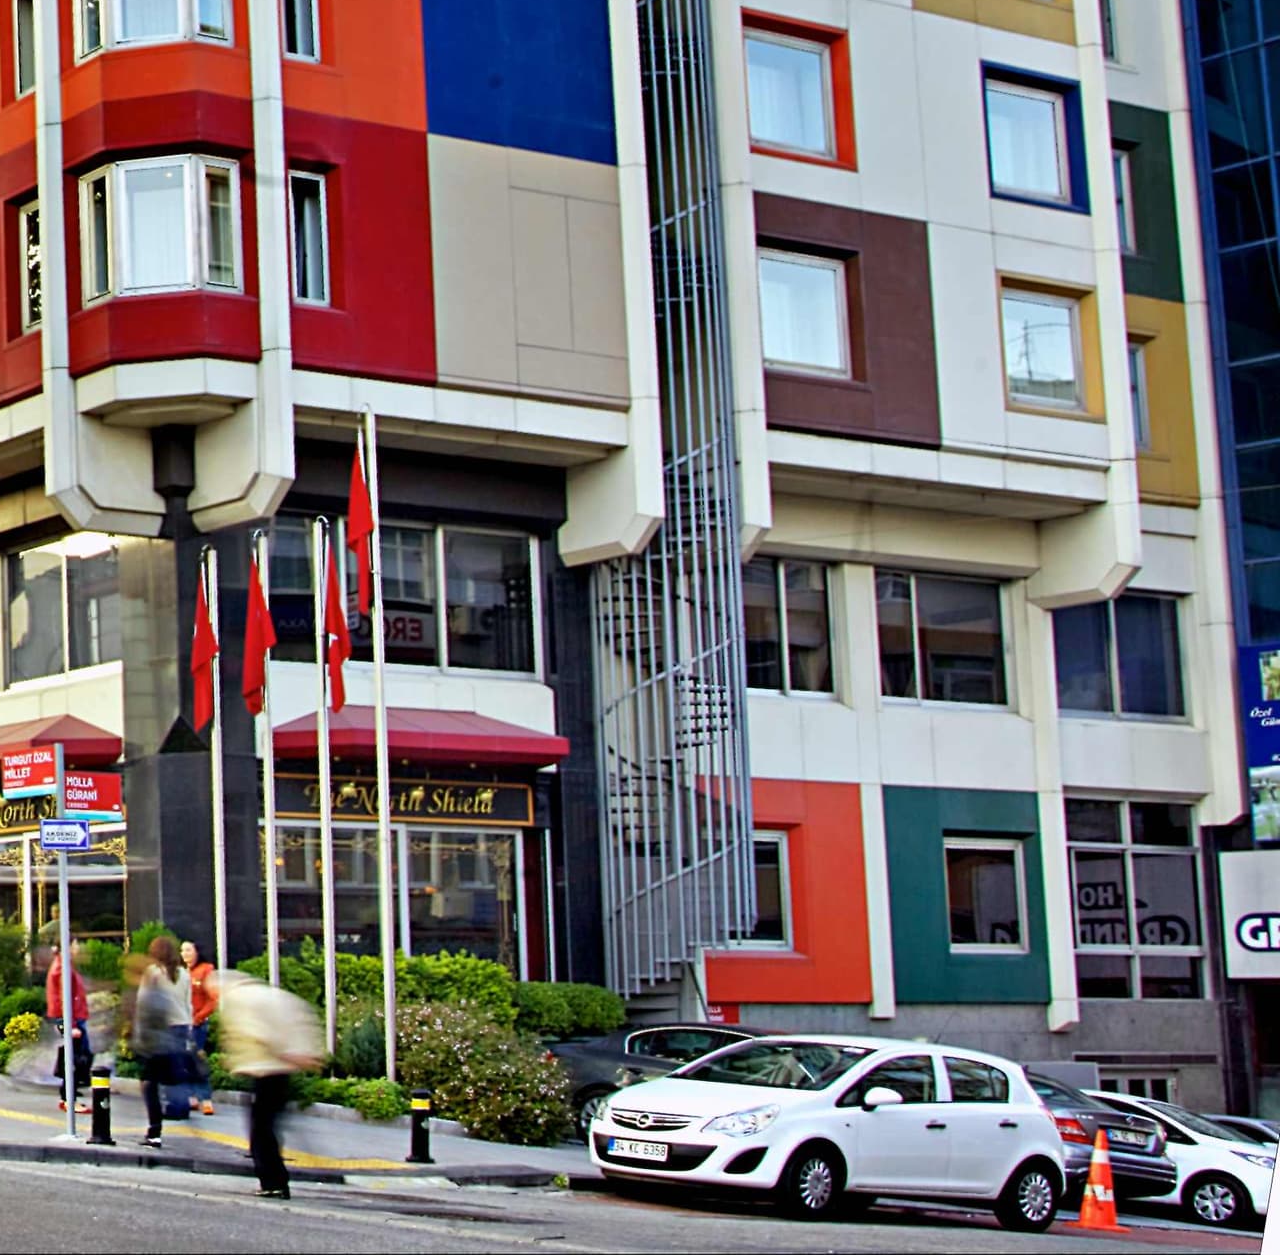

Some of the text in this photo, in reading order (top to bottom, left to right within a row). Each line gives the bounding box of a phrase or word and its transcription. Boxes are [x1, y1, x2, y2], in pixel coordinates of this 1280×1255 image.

[4, 751, 53, 766] TURGUT ÖZAL
[4, 767, 31, 779] MİLLET
[66, 776, 93, 787] MOLLA
[66, 789, 97, 801] GÜRANİ
[427, 785, 497, 815] Shield
